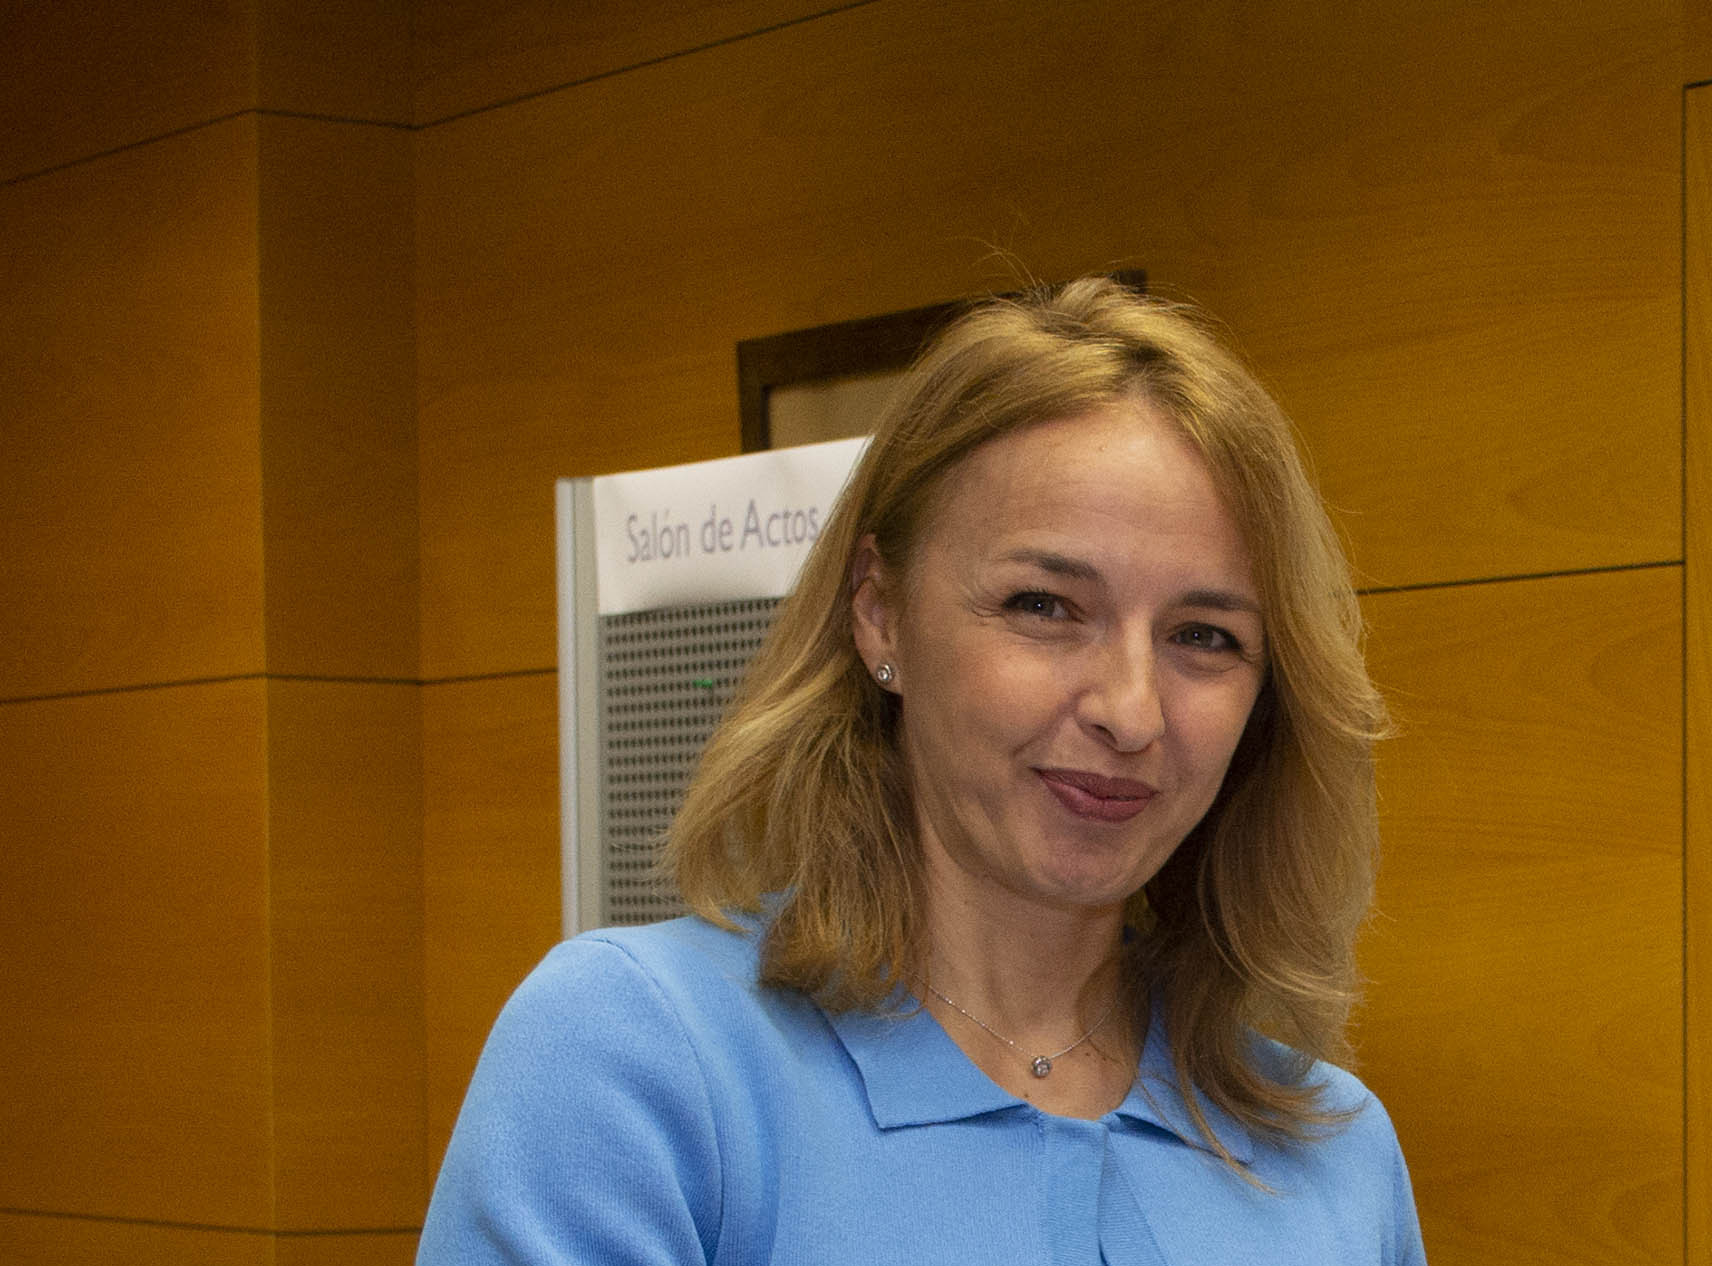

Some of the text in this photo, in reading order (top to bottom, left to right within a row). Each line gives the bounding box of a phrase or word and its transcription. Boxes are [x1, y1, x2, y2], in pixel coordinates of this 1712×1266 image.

[627, 499, 818, 563] Salón de Actos
